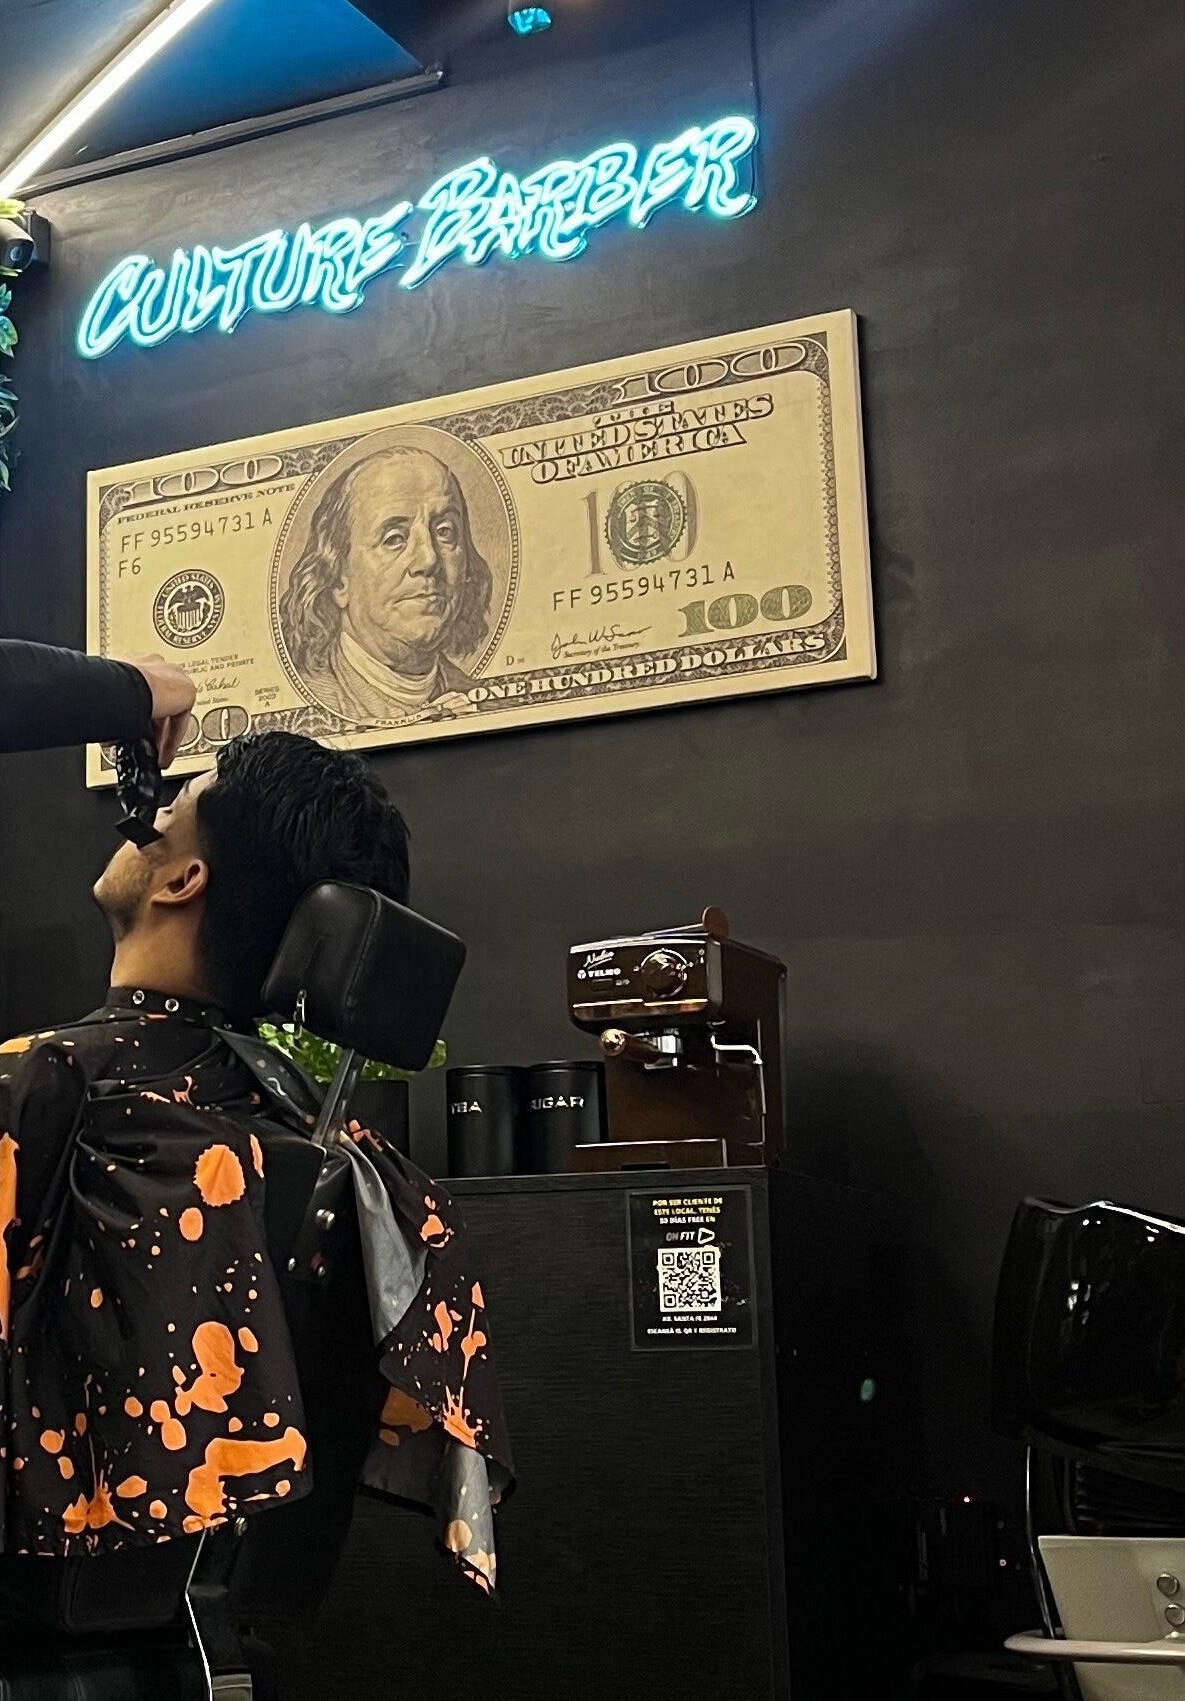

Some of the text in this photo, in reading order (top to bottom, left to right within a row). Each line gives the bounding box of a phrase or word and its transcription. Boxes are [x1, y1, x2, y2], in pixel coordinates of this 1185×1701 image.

[76, 113, 760, 360] CULTURE BARBER
[612, 341, 806, 405] 100
[500, 393, 774, 470] UNITED STATES
[530, 423, 747, 484] OF AMERICA
[117, 483, 296, 525] FEDERAL RESERVE NOTE
[122, 455, 284, 508] 100
[120, 507, 273, 553] FF 95594731 A
[118, 557, 142, 578] F6
[552, 560, 735, 612] FF 95594731 A
[678, 584, 813, 638] 100
[467, 634, 827, 703] ONE HUNDRED DOLLARS
